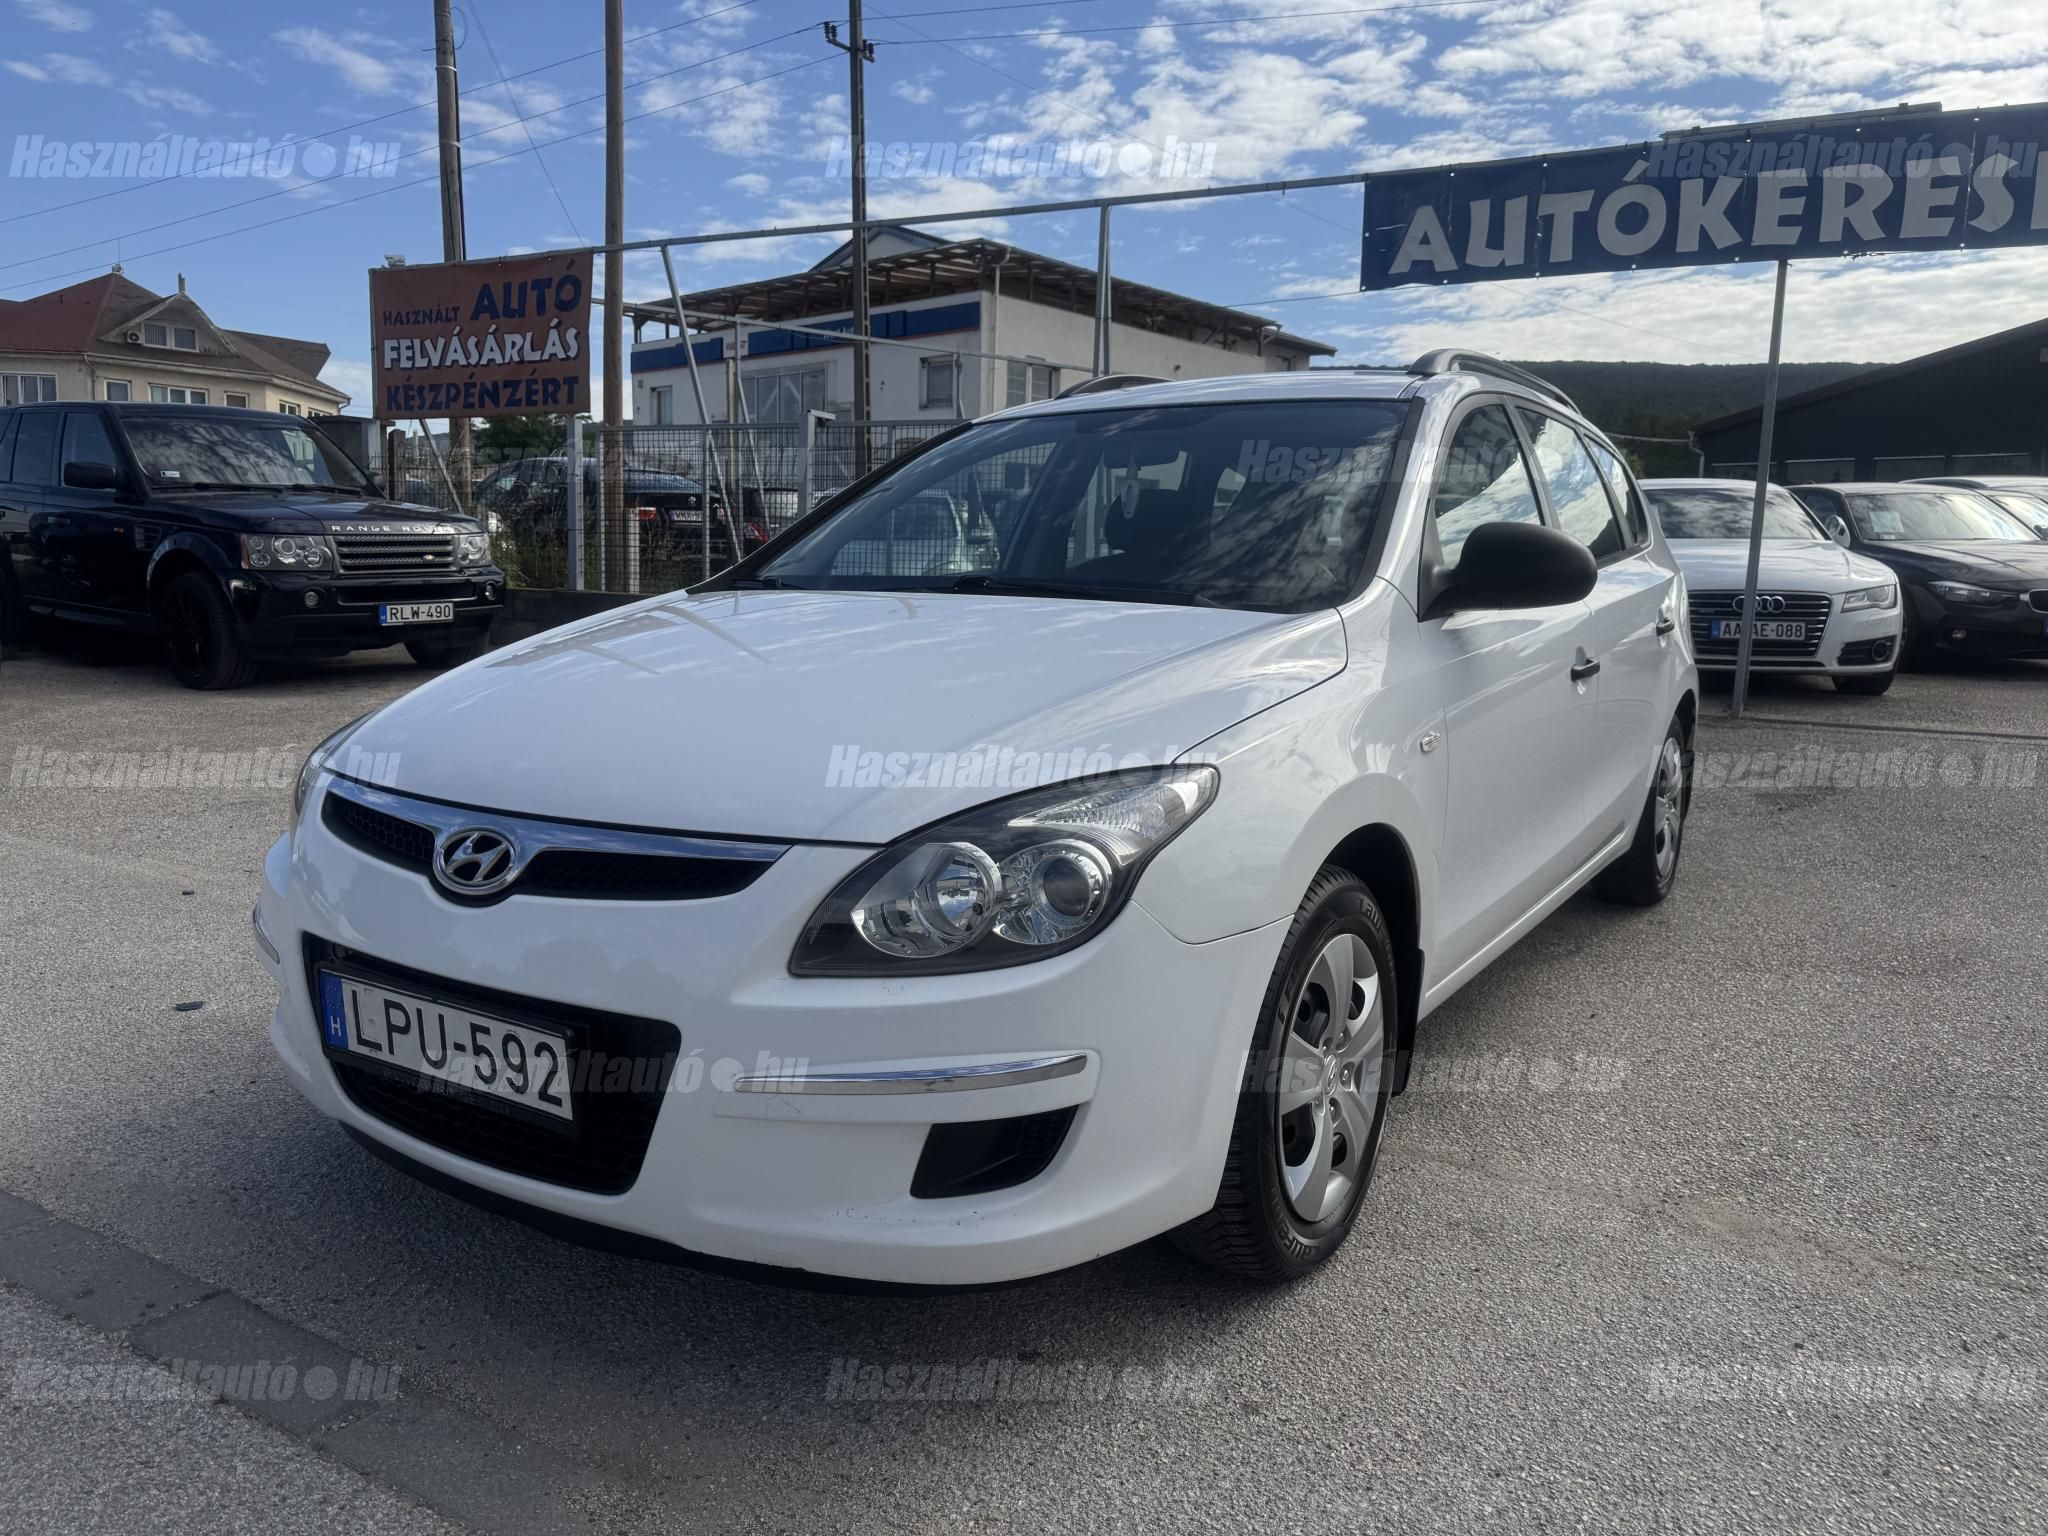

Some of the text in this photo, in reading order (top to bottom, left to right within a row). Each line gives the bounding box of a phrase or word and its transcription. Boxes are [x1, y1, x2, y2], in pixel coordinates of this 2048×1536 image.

[383, 258, 582, 326] HASZNÁLT AUTÓ
[383, 317, 580, 370] FELVÁSÁRLÁS
[386, 367, 579, 411] KÉSZPÉNZÉRT
[389, 604, 451, 621] RLW-490
[330, 1015, 342, 1037] H
[351, 989, 563, 1108] LPU-592
